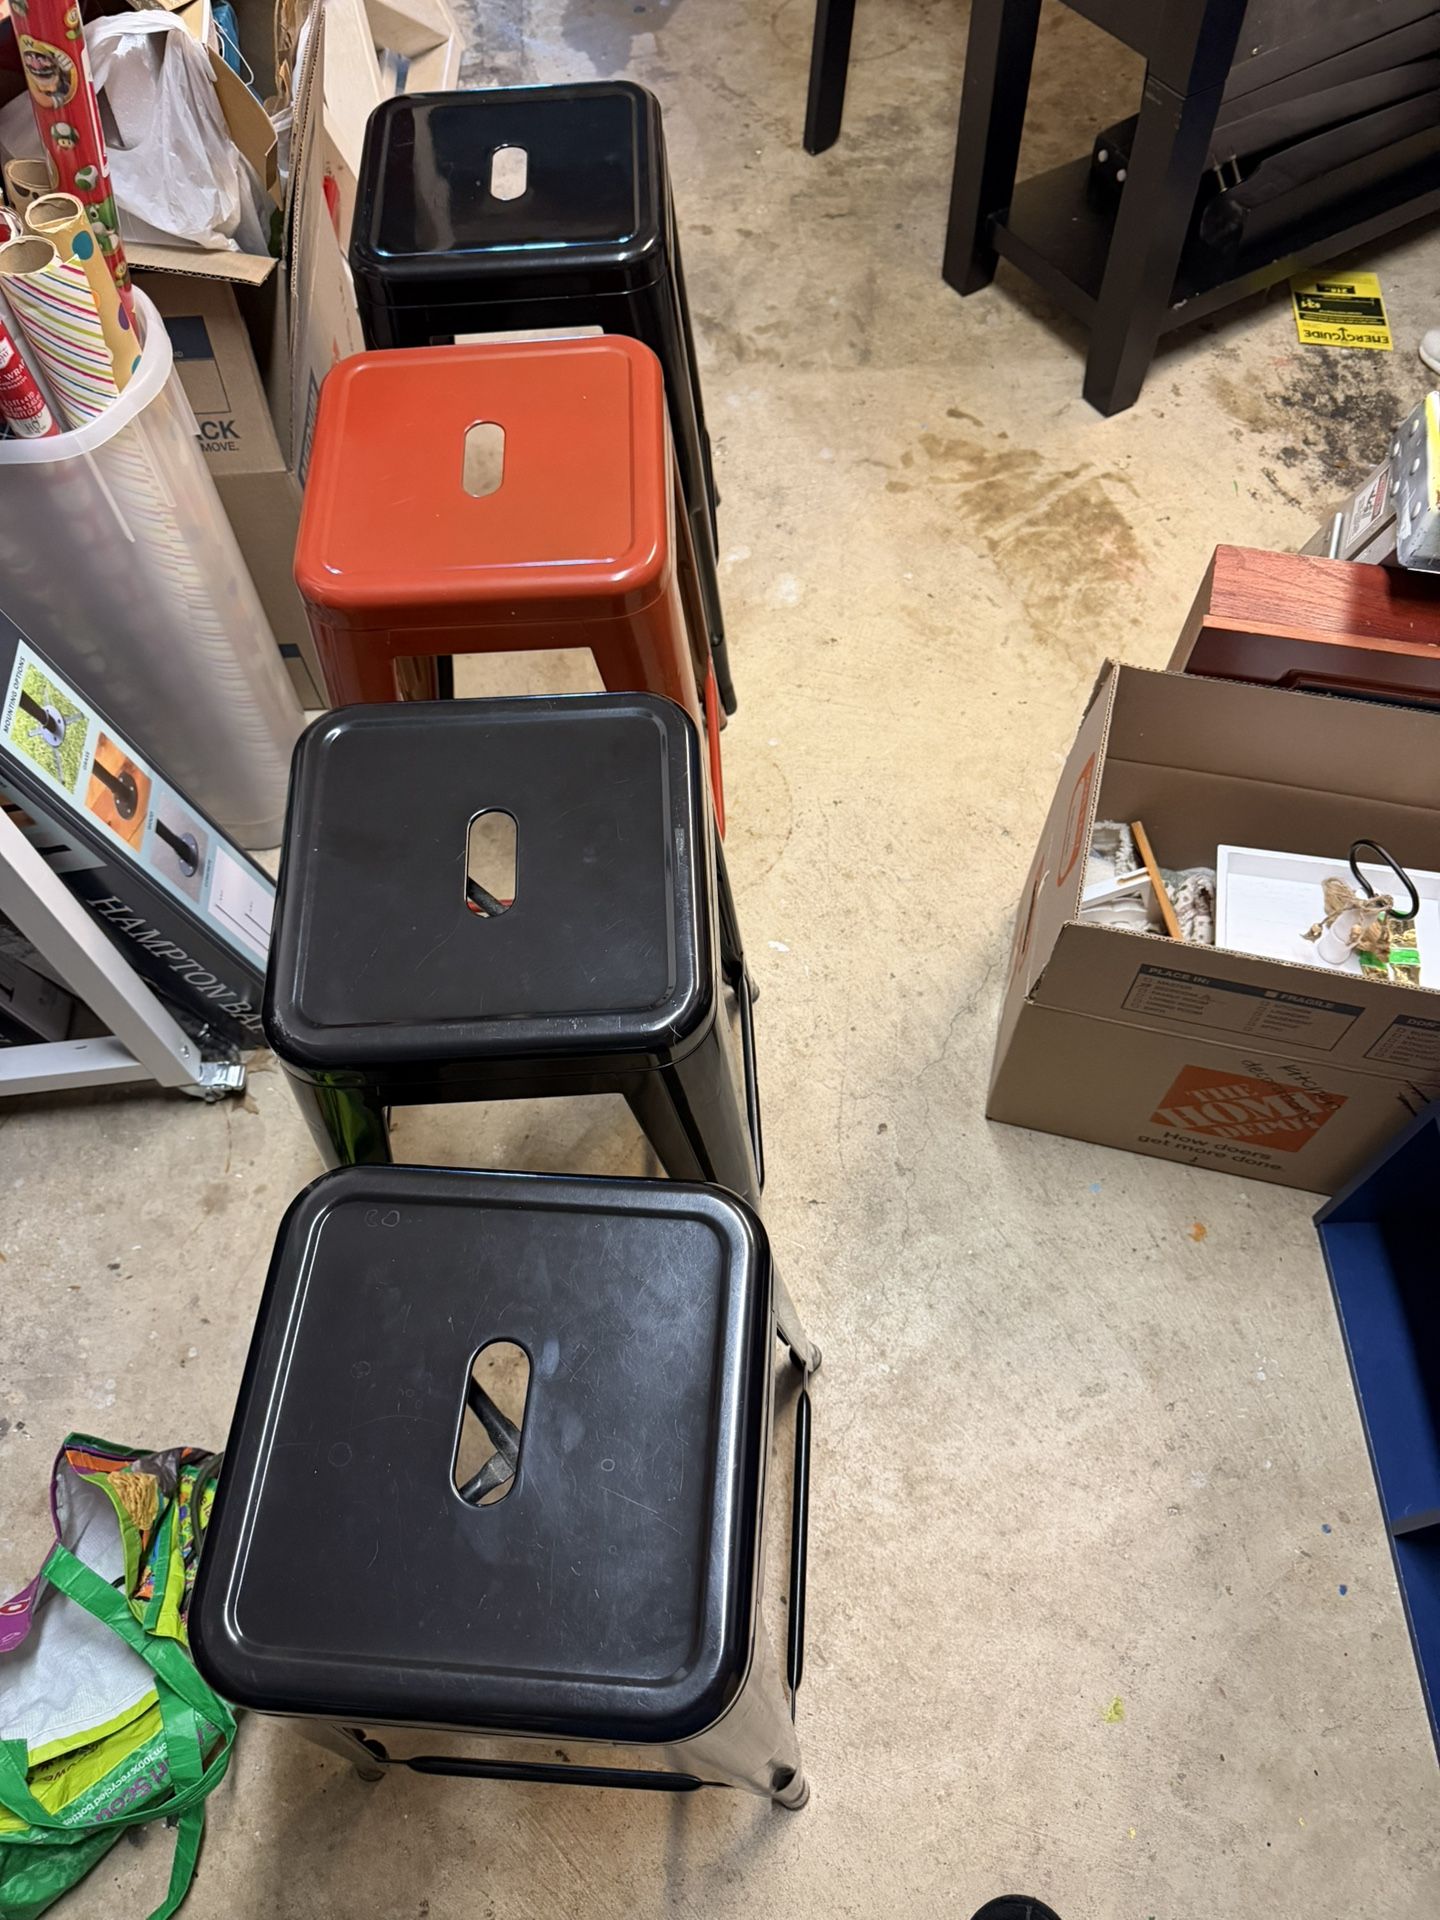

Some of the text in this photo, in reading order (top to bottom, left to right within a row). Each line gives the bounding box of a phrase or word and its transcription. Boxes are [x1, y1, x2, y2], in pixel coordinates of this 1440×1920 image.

[194, 420, 241, 441] CK
[3, 656, 25, 734] MOUNTING OPTIONS
[86, 895, 238, 999] HAMPTON
[1147, 967, 1191, 983] PLACE
[1278, 993, 1335, 1010] FRAGILE
[1185, 1083, 1258, 1103] THE
[1156, 1089, 1330, 1128] HOME
[1212, 1119, 1321, 1139] DEPOT
[1138, 1134, 1286, 1172] get more done.
[1163, 1131, 1273, 1160] How doers
[131, 1751, 157, 1774] 100%
[94, 1770, 132, 1804] recycled
